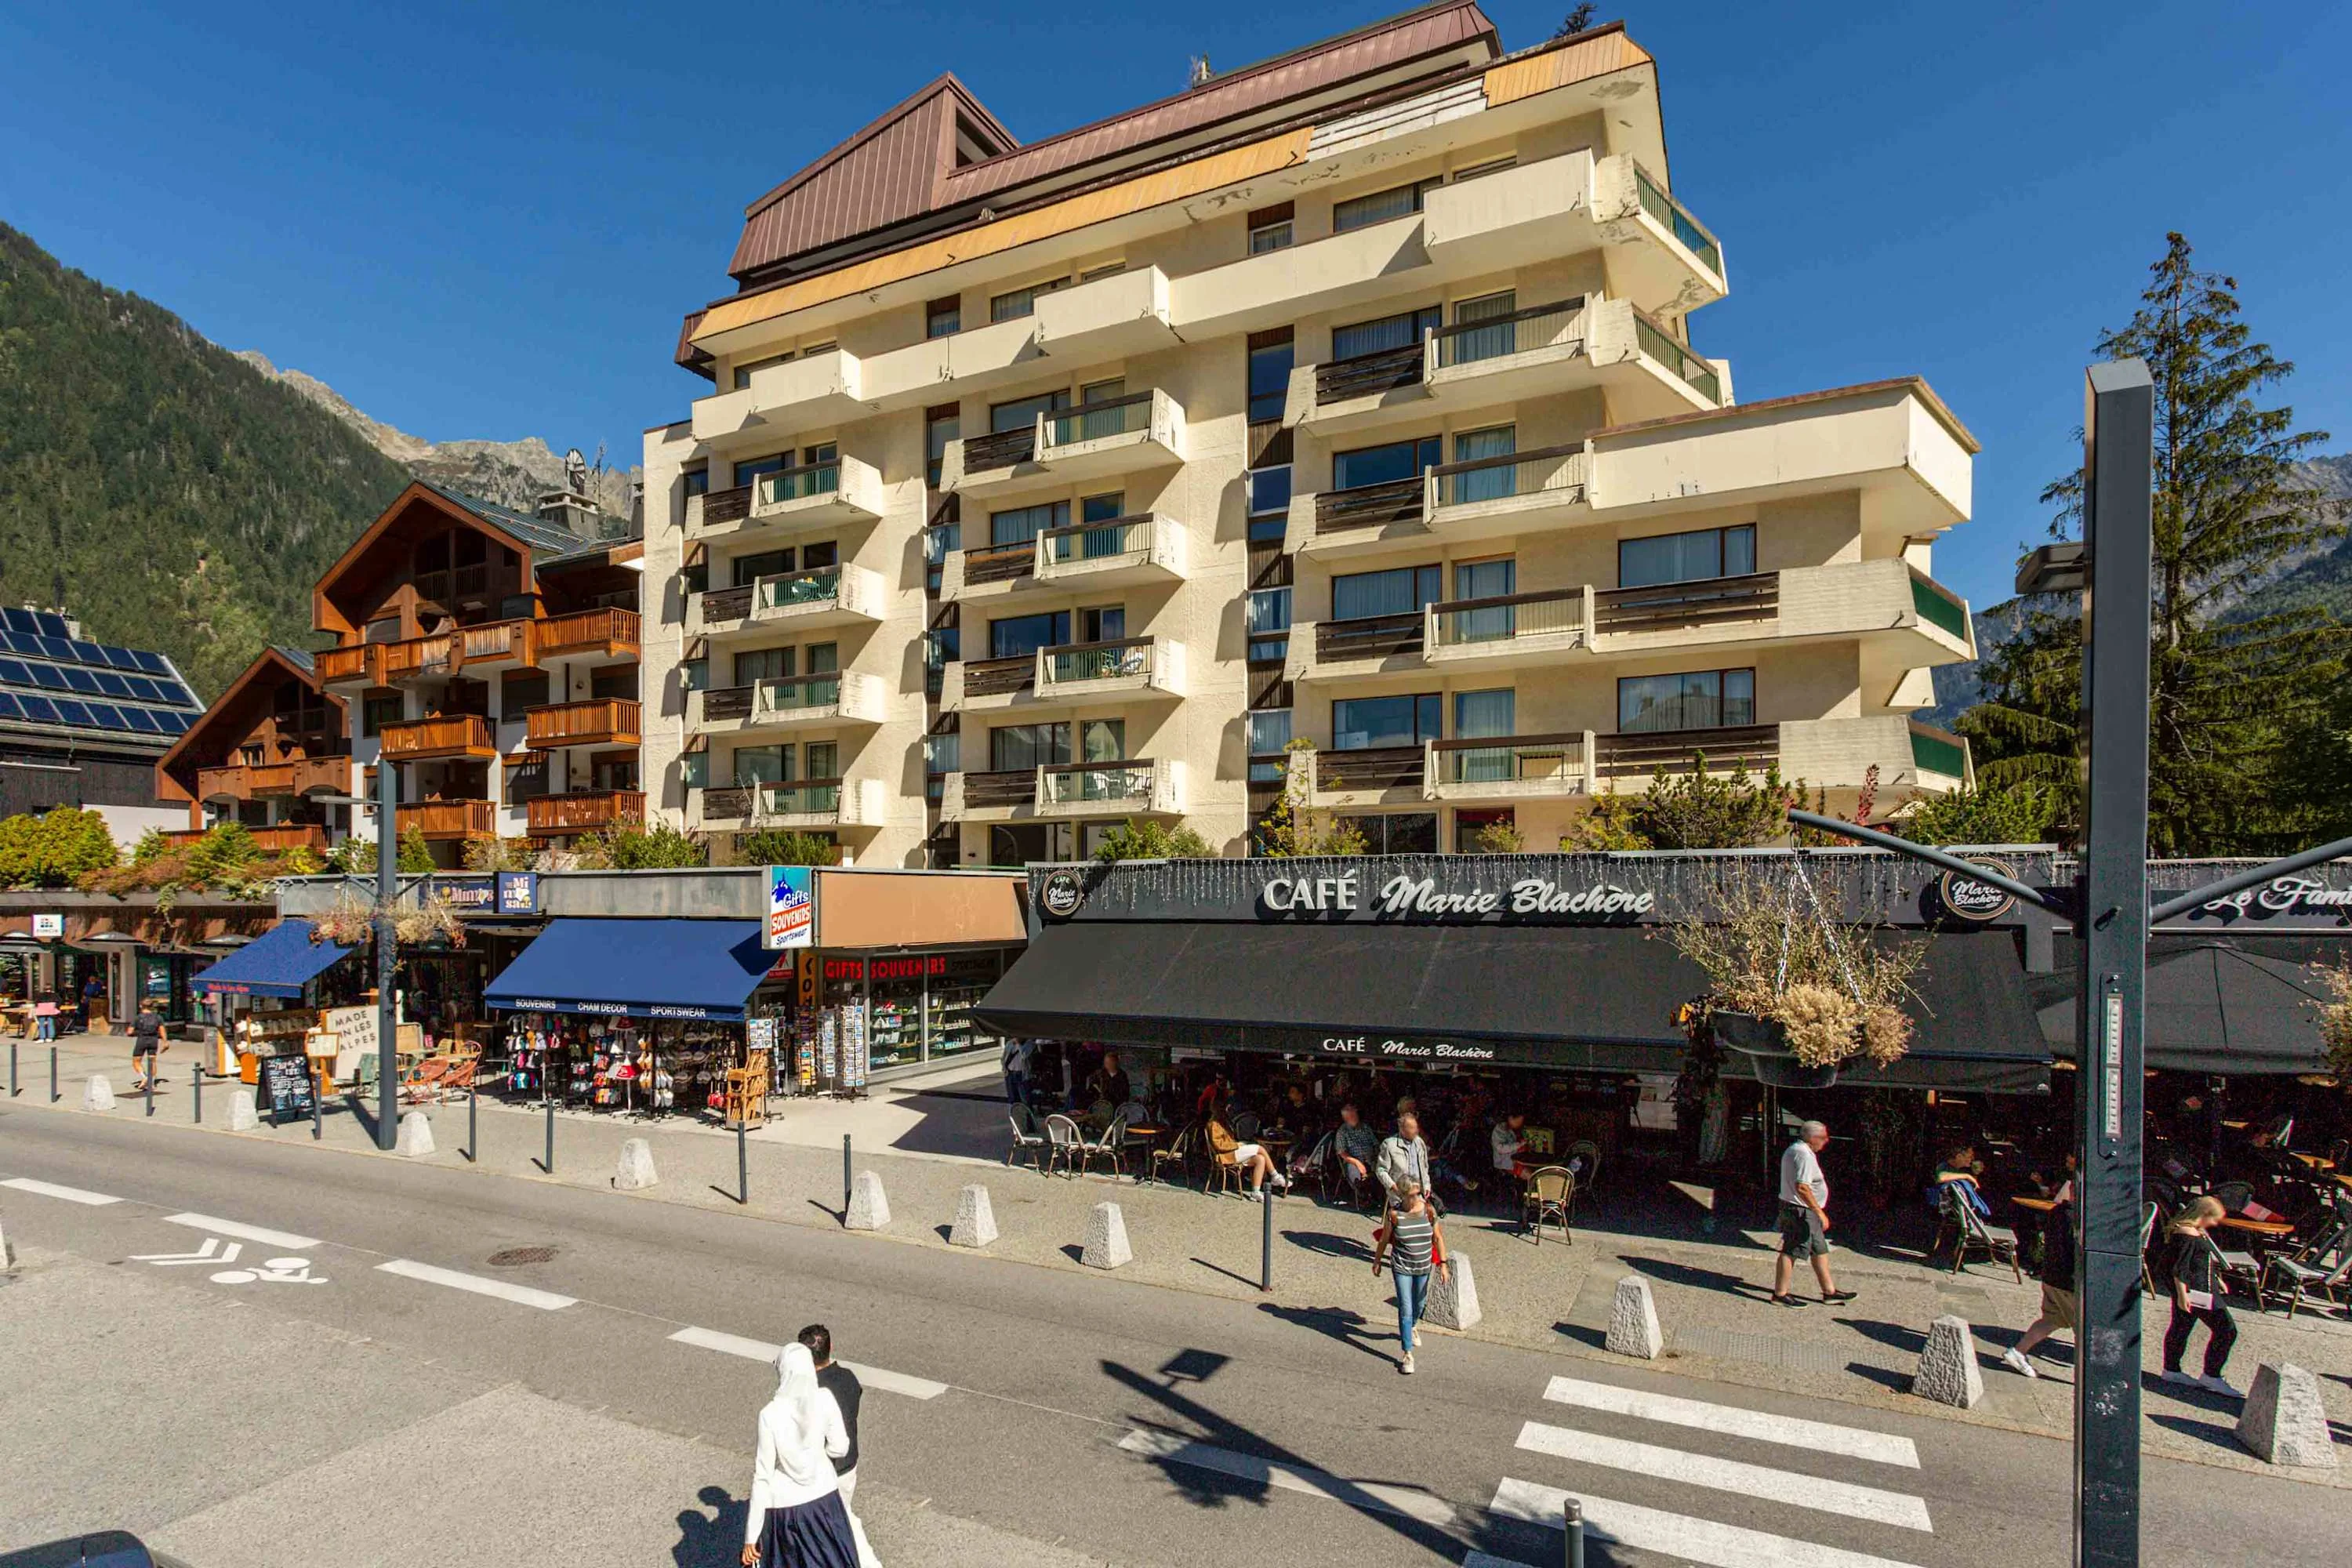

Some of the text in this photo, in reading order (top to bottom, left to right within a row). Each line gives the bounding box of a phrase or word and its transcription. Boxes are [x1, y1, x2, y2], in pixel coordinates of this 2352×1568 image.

[783, 890, 810, 909] Gifts
[1263, 869, 1653, 914] CAFÉ Marie Blachère
[771, 906, 811, 933] SOUVENIRS
[776, 927, 808, 946] Sportswear
[825, 956, 946, 979] GIFTS SOUVENIRS
[515, 998, 706, 1018] SOUVENIRS CHAM DECOR SPORTSWEAR
[336, 1010, 368, 1026] MADE
[354, 1020, 372, 1033] LES
[339, 1033, 376, 1051] ALPES
[1323, 1036, 1494, 1058] CAFÉ Marie Blachère
